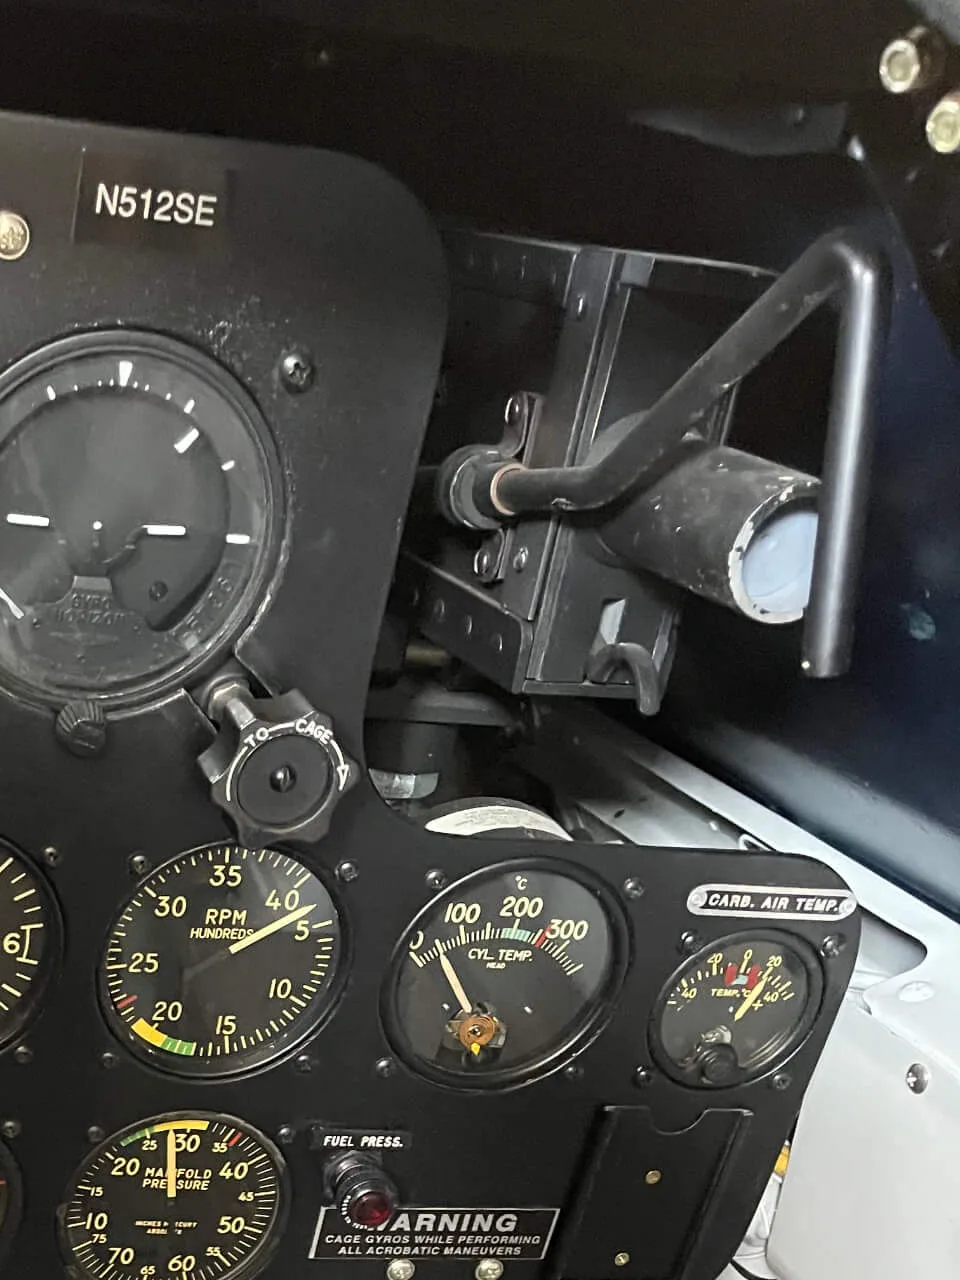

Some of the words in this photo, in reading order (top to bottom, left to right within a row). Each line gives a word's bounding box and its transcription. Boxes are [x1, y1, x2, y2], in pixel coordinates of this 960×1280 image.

[95, 183, 217, 226] N512SE
[244, 728, 269, 747] TO
[295, 719, 333, 744] CAGE
[209, 866, 241, 886] 35
[154, 896, 186, 917] 30
[265, 890, 299, 910] 40
[500, 896, 543, 918] 200
[709, 893, 754, 908] CARB.
[761, 897, 787, 909] AIR
[796, 898, 838, 912] TEMP.
[205, 909, 246, 925] RPM
[444, 903, 481, 923] 100
[190, 928, 253, 939] HUNDREDS
[294, 921, 309, 941] 5
[545, 919, 588, 940] 300
[3, 933, 20, 954] 6
[128, 953, 159, 972] 25
[498, 950, 533, 961] TEMP.
[269, 979, 291, 998] 10
[152, 1002, 182, 1021] 20
[215, 1016, 236, 1035] 15
[142, 1140, 158, 1150] 25
[174, 1134, 200, 1152] 30
[212, 1142, 228, 1153] 35
[323, 1136, 354, 1147] FUEL
[360, 1136, 403, 1148] PRESS.
[111, 1158, 140, 1175] 20
[145, 1167, 212, 1179] MAFOLD
[219, 1162, 249, 1179] 40
[90, 1187, 104, 1197] 15
[142, 1179, 210, 1190] PRESURE
[238, 1192, 254, 1201] 45
[85, 1213, 108, 1229] 10
[217, 1216, 245, 1234] 50
[91, 1234, 107, 1243] 75
[325, 1235, 360, 1244] CAGE
[365, 1235, 410, 1245] GYROS
[414, 1236, 453, 1245] WHILE
[458, 1235, 540, 1246] PERFORMING
[108, 1248, 134, 1265] 70
[205, 1247, 220, 1256] 55
[338, 1246, 362, 1255] ALL
[366, 1246, 440, 1255] ACROBATIC
[443, 1246, 522, 1256] MANEUVERS
[140, 1266, 155, 1275] 65
[168, 1255, 195, 1272] 60
